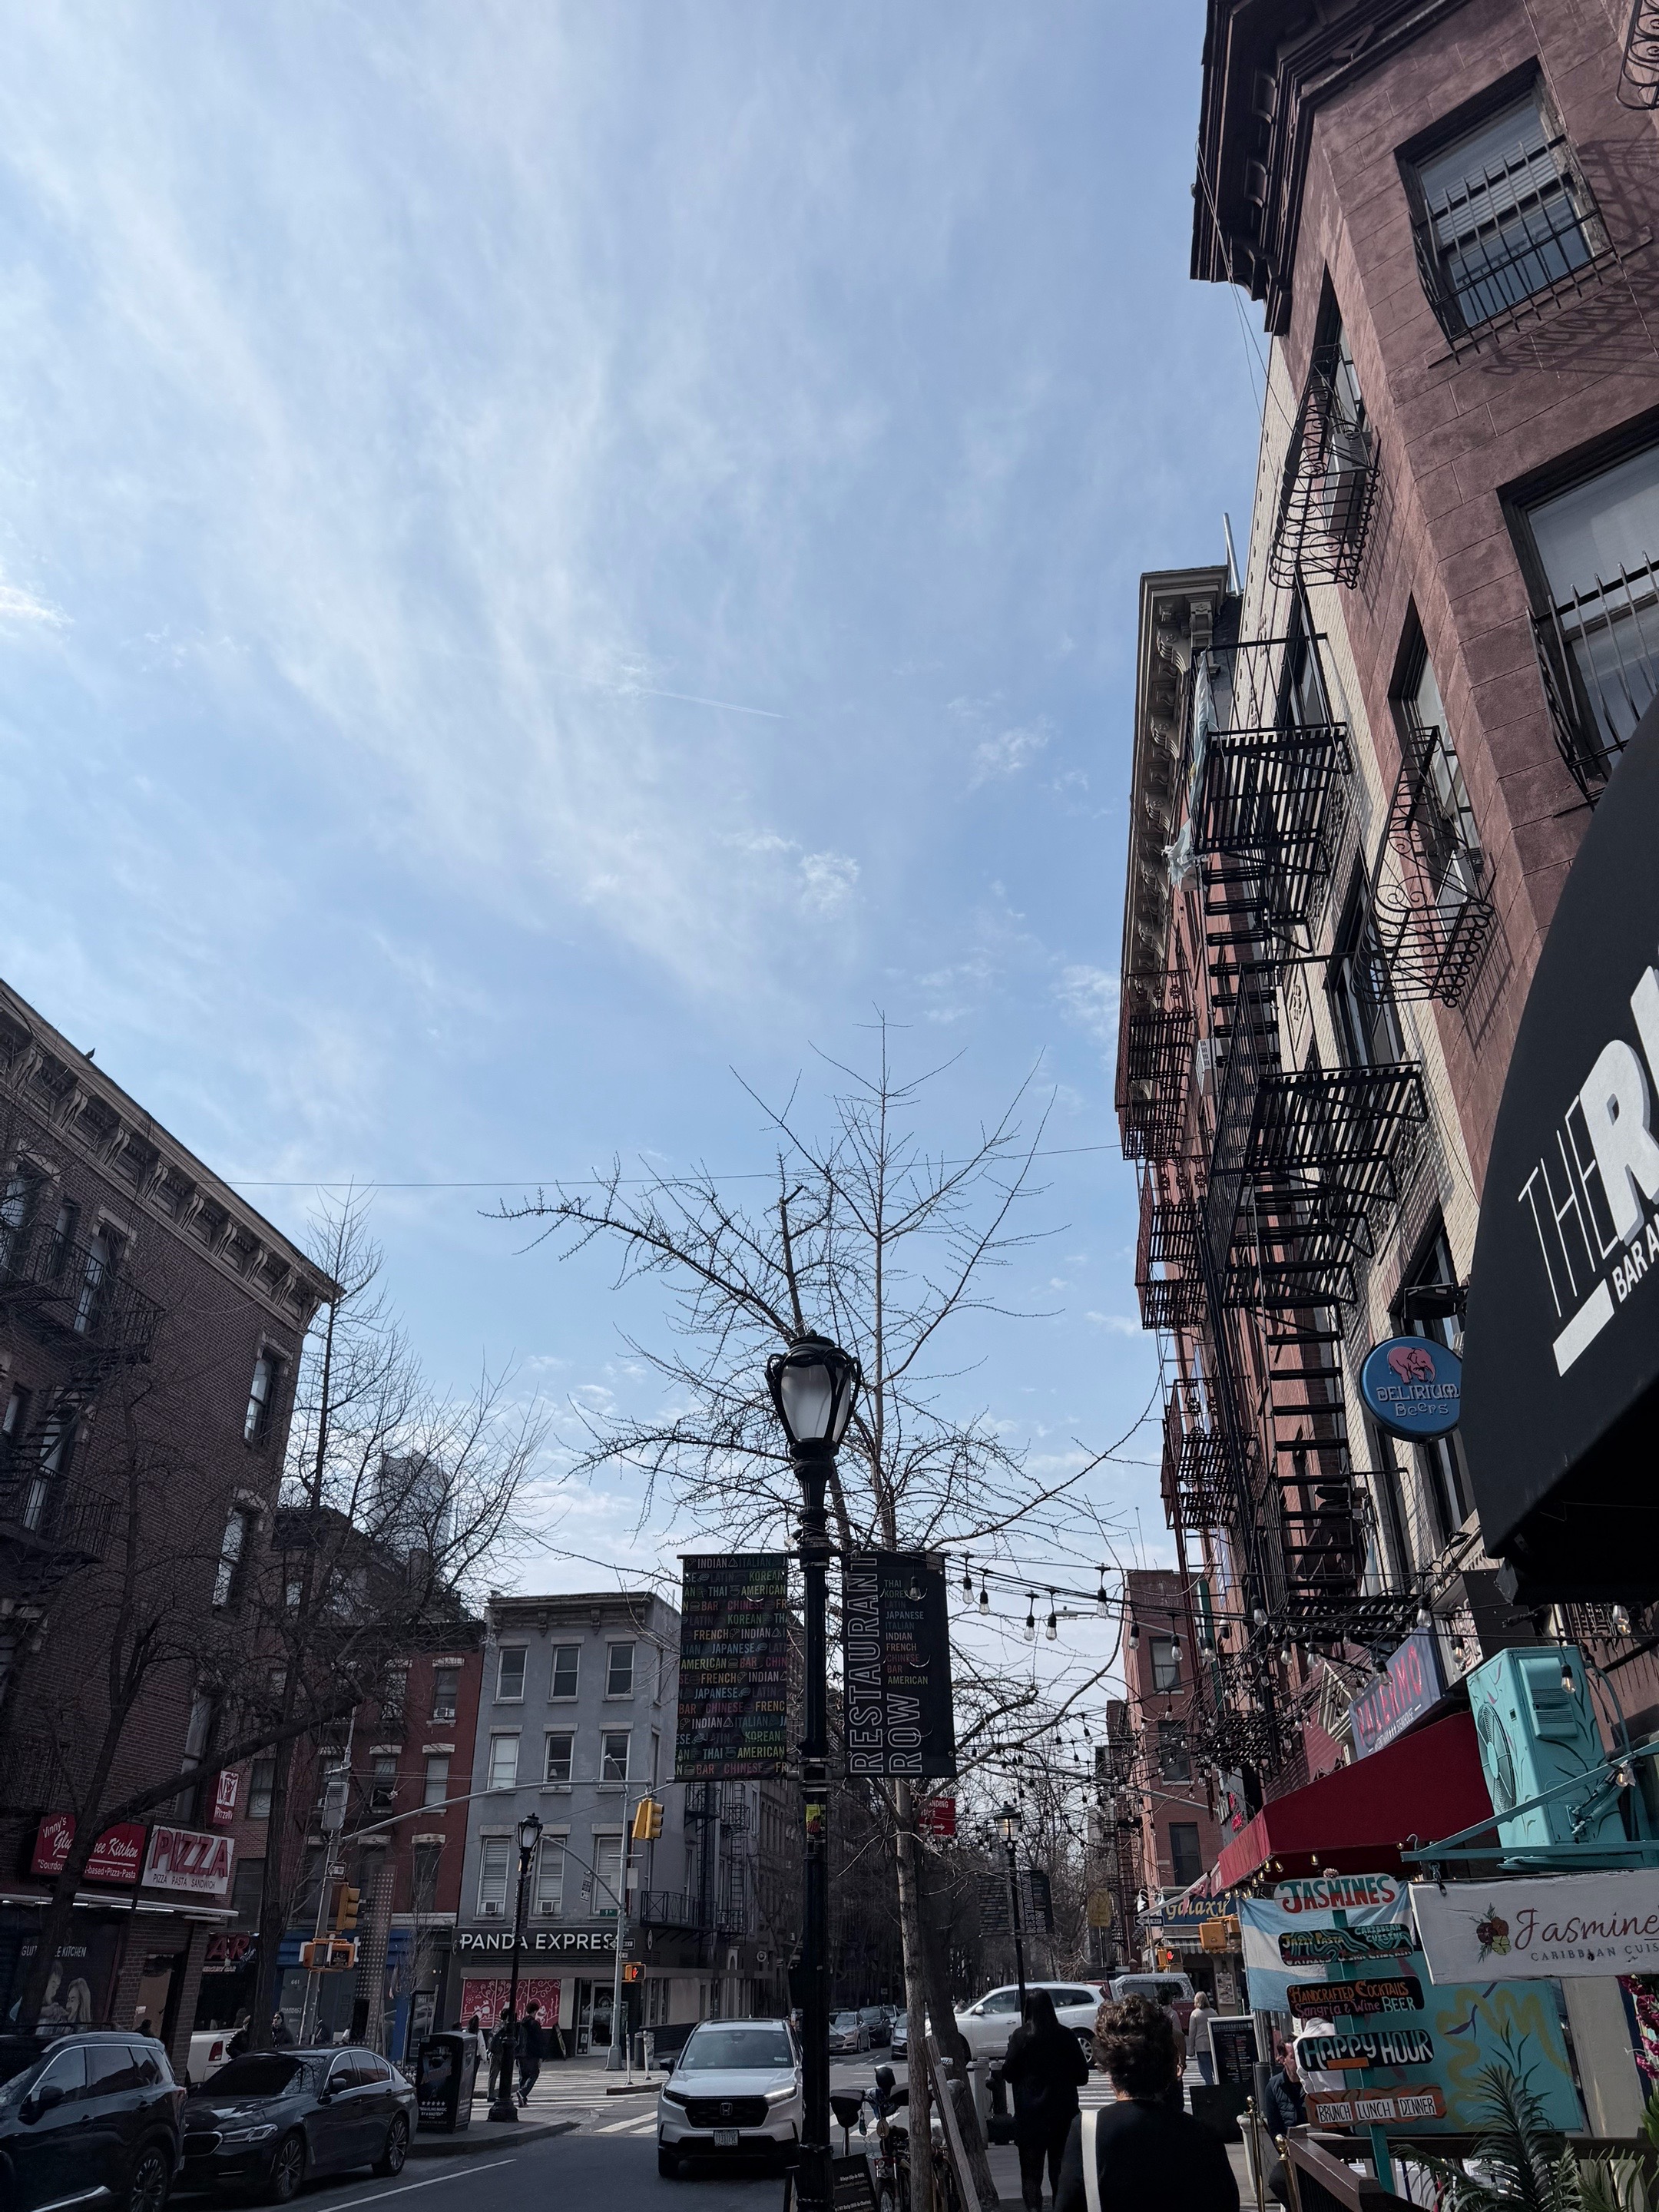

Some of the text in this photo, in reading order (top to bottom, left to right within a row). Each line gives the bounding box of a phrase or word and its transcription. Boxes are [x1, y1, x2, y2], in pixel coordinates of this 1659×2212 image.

[1518, 1094, 1618, 1318] THE
[1612, 1240, 1648, 1303] BAR
[1376, 1384, 1459, 1401] DELIRIUM
[697, 1558, 727, 1568] INDIAN
[739, 1557, 771, 1568] ITALIAN
[710, 1572, 734, 1583] LATIN
[749, 1570, 783, 1581] KOREAN
[884, 1579, 902, 1588] THAI
[708, 1586, 727, 1597] THAI
[741, 1584, 786, 1596] AMERICAN
[701, 1601, 719, 1611] BAR
[727, 1600, 764, 1611] CHINESE
[884, 1601, 906, 1609] LATIN
[689, 1615, 714, 1626] LATIN
[727, 1614, 762, 1624] KOREAN
[885, 1611, 925, 1620] JAPANESE
[885, 1621, 915, 1631] ITALIAN
[694, 1629, 729, 1641] FRENCH
[741, 1628, 771, 1639] INDIAN
[886, 1632, 913, 1641] INDIAN
[711, 1642, 755, 1654] JAPANESE
[886, 1643, 917, 1651] FRENCH
[680, 1657, 727, 1671] AMERICAN
[740, 1657, 757, 1668] BAR
[886, 1654, 920, 1662] CHINESE
[846, 1558, 884, 1773] RESTAURANT
[887, 1664, 902, 1674] BAR
[700, 1673, 737, 1684] FRENCH
[748, 1671, 780, 1683] INDIAN
[887, 1676, 929, 1685] AMERICAN
[694, 1687, 738, 1700] JAPANESE
[752, 1687, 777, 1698] LATIN
[1356, 1645, 1422, 1747] PALERMO
[678, 1704, 697, 1715] BAR
[705, 1702, 743, 1714] CHINESE
[691, 1717, 723, 1730] INDIAN
[734, 1716, 768, 1728] ITALIAN
[744, 1730, 781, 1743] KOREAN
[886, 1692, 923, 1773] ROW
[702, 1747, 724, 1760] THAI
[737, 1746, 786, 1759] AMERICAN
[696, 1764, 714, 1775] BAR
[724, 1762, 764, 1774] CHINESE
[928, 1800, 949, 1809] ANDING
[43, 1816, 68, 1839] Vinny's
[52, 1830, 138, 1858] Glu ree Kitchen
[149, 1829, 228, 1878] PIZZA
[153, 1873, 216, 1889] PIZZA PASTA SANDWICH
[1280, 1876, 1396, 1913] JASMINES
[1165, 1899, 1227, 1920] Galaxy
[1354, 1924, 1402, 1936] CARIBBEAN
[461, 1933, 529, 1950] PANDA
[1314, 1932, 1344, 1945] PASTA
[1366, 1932, 1405, 1943] CUISINE
[21, 1945, 38, 1957] GLUT
[61, 1945, 88, 1958] KITCHEN
[206, 1934, 250, 1960] AR
[1288, 1980, 1409, 2004] HANDCRAFTED COCKTAILS
[1294, 2002, 1342, 2018] Sangria
[1351, 2000, 1381, 2012] Wine
[1381, 1996, 1416, 2013] BEER
[1377, 2030, 1434, 2065] HOUR
[1318, 2098, 1435, 2123] BRUNCH LUNCH DINNER
